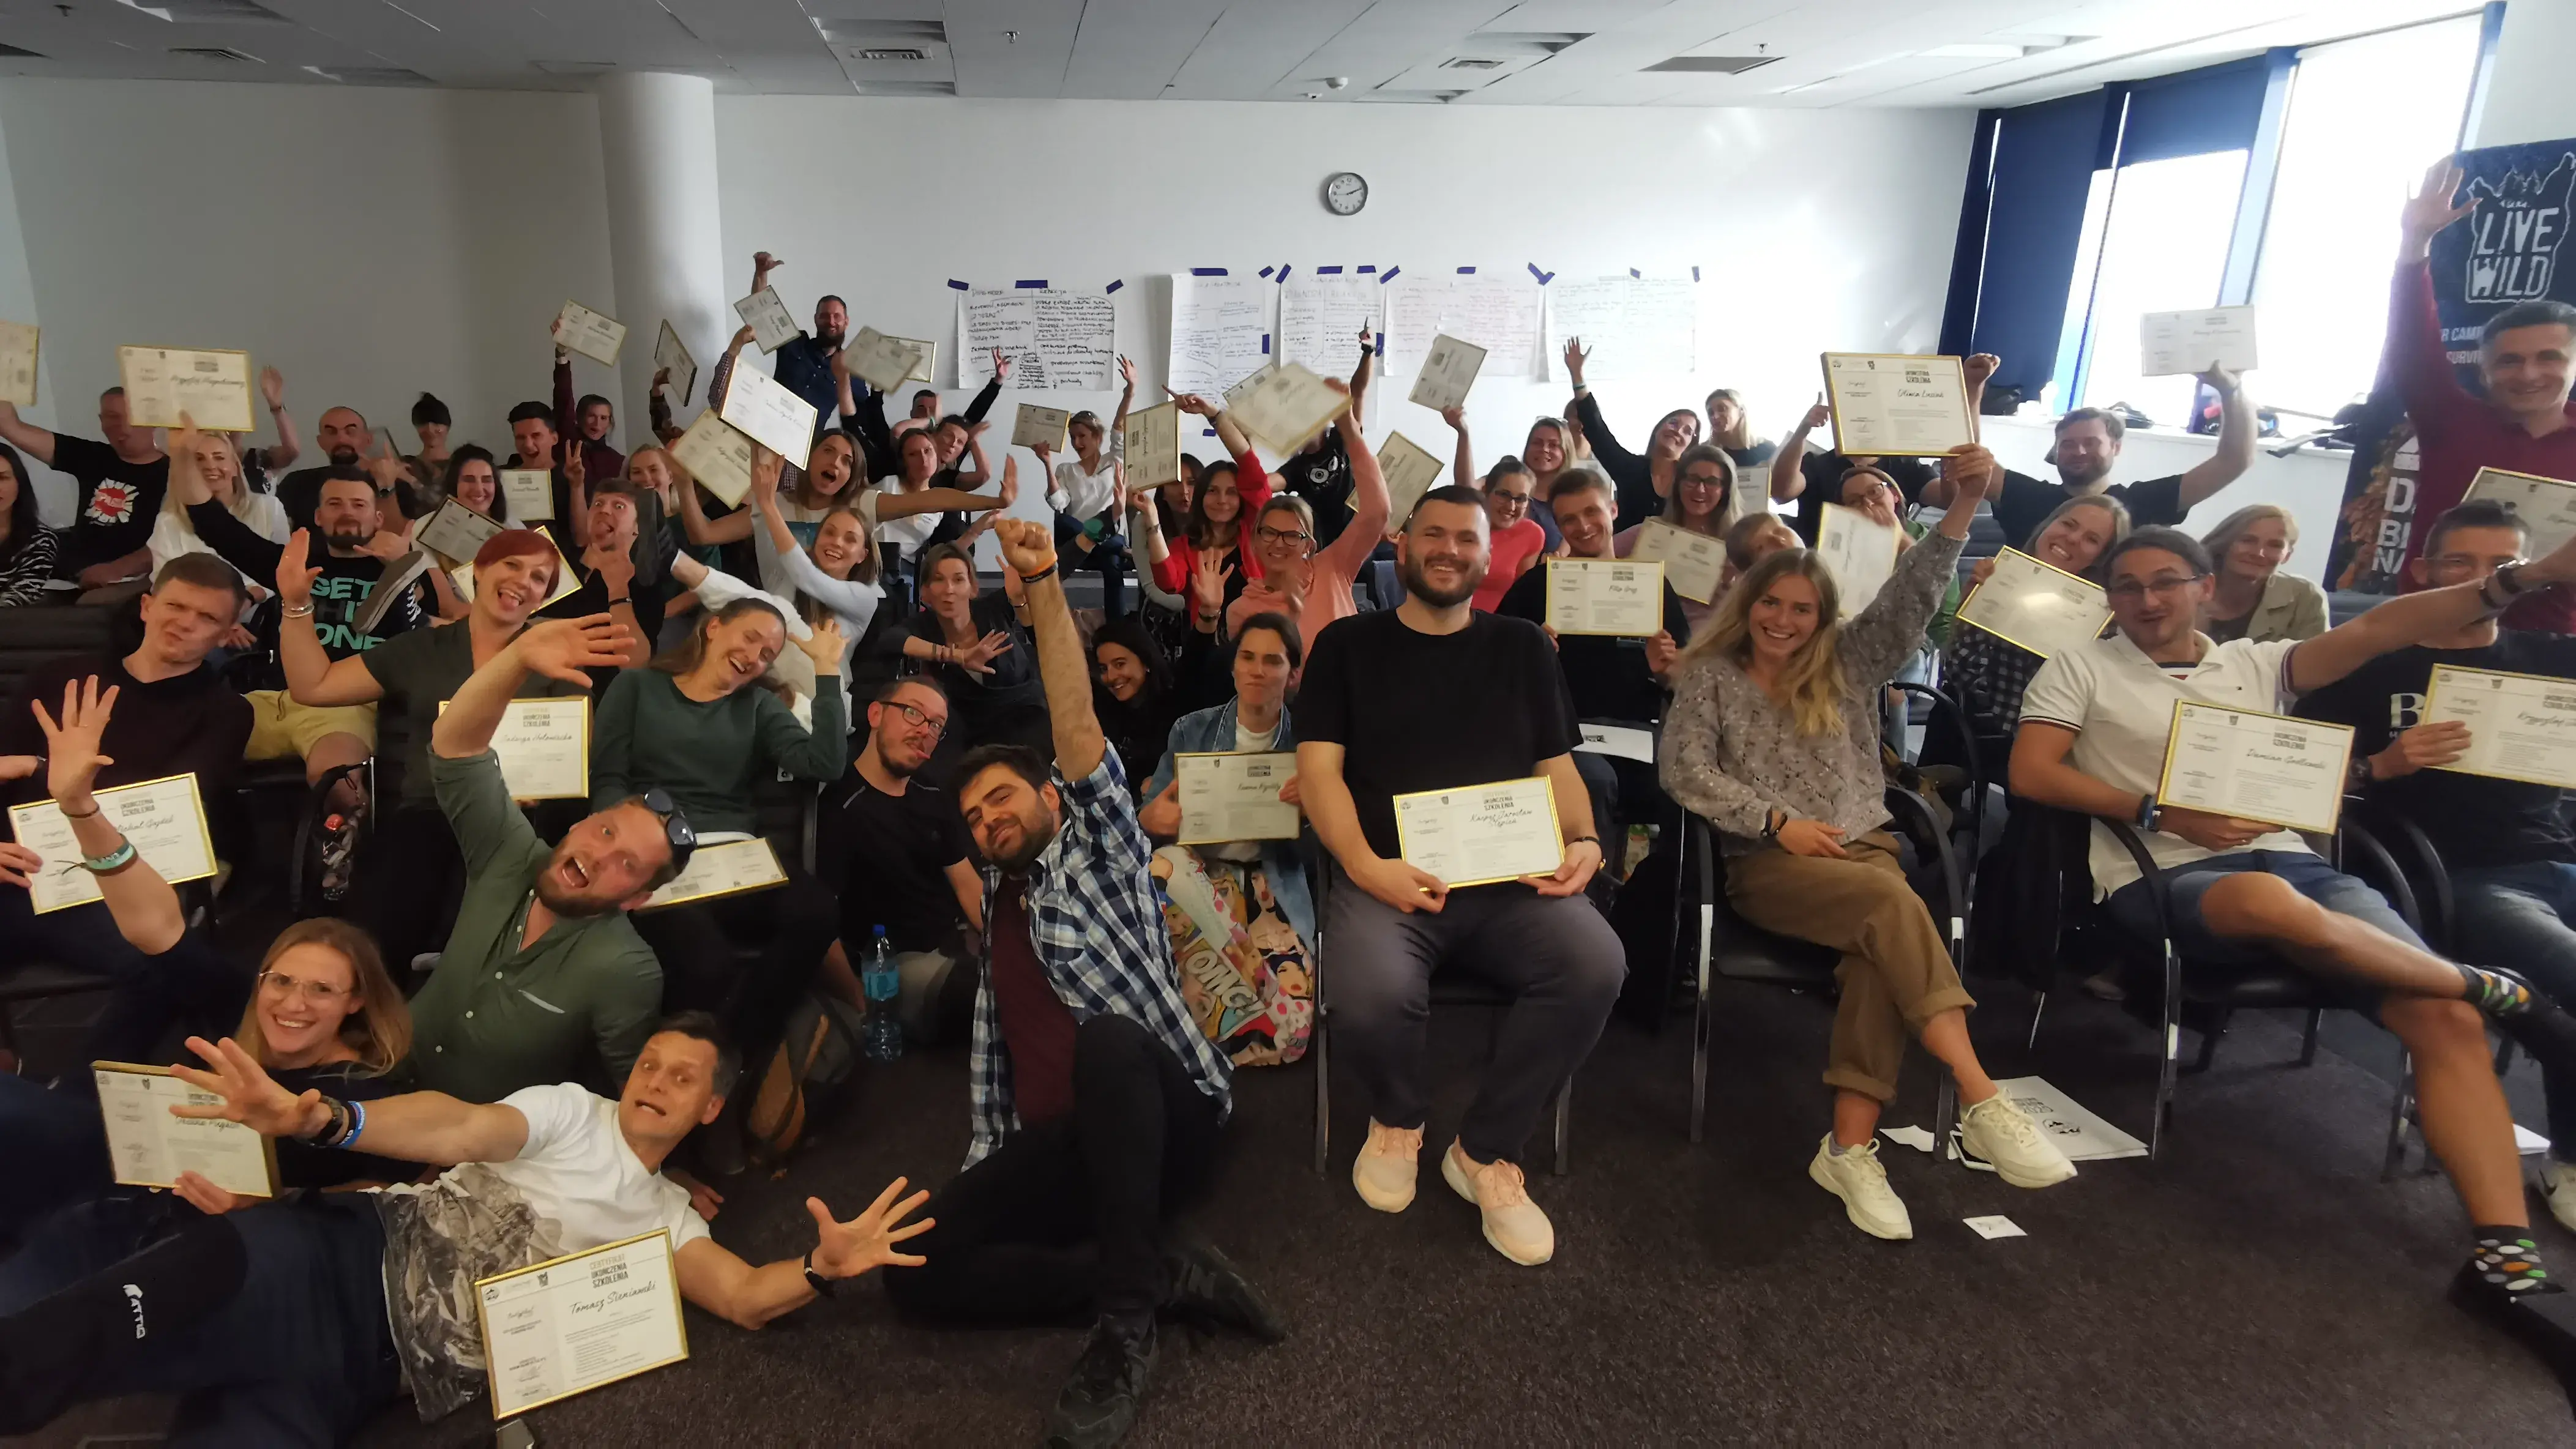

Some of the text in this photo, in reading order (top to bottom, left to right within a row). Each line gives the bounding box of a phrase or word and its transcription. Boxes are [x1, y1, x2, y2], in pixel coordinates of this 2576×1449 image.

[2477, 207, 2559, 255] LIVE
[2472, 255, 2550, 297] WILD
[592, 1271, 629, 1289] SZKOLENIA
[569, 1298, 605, 1315] Tomasz
